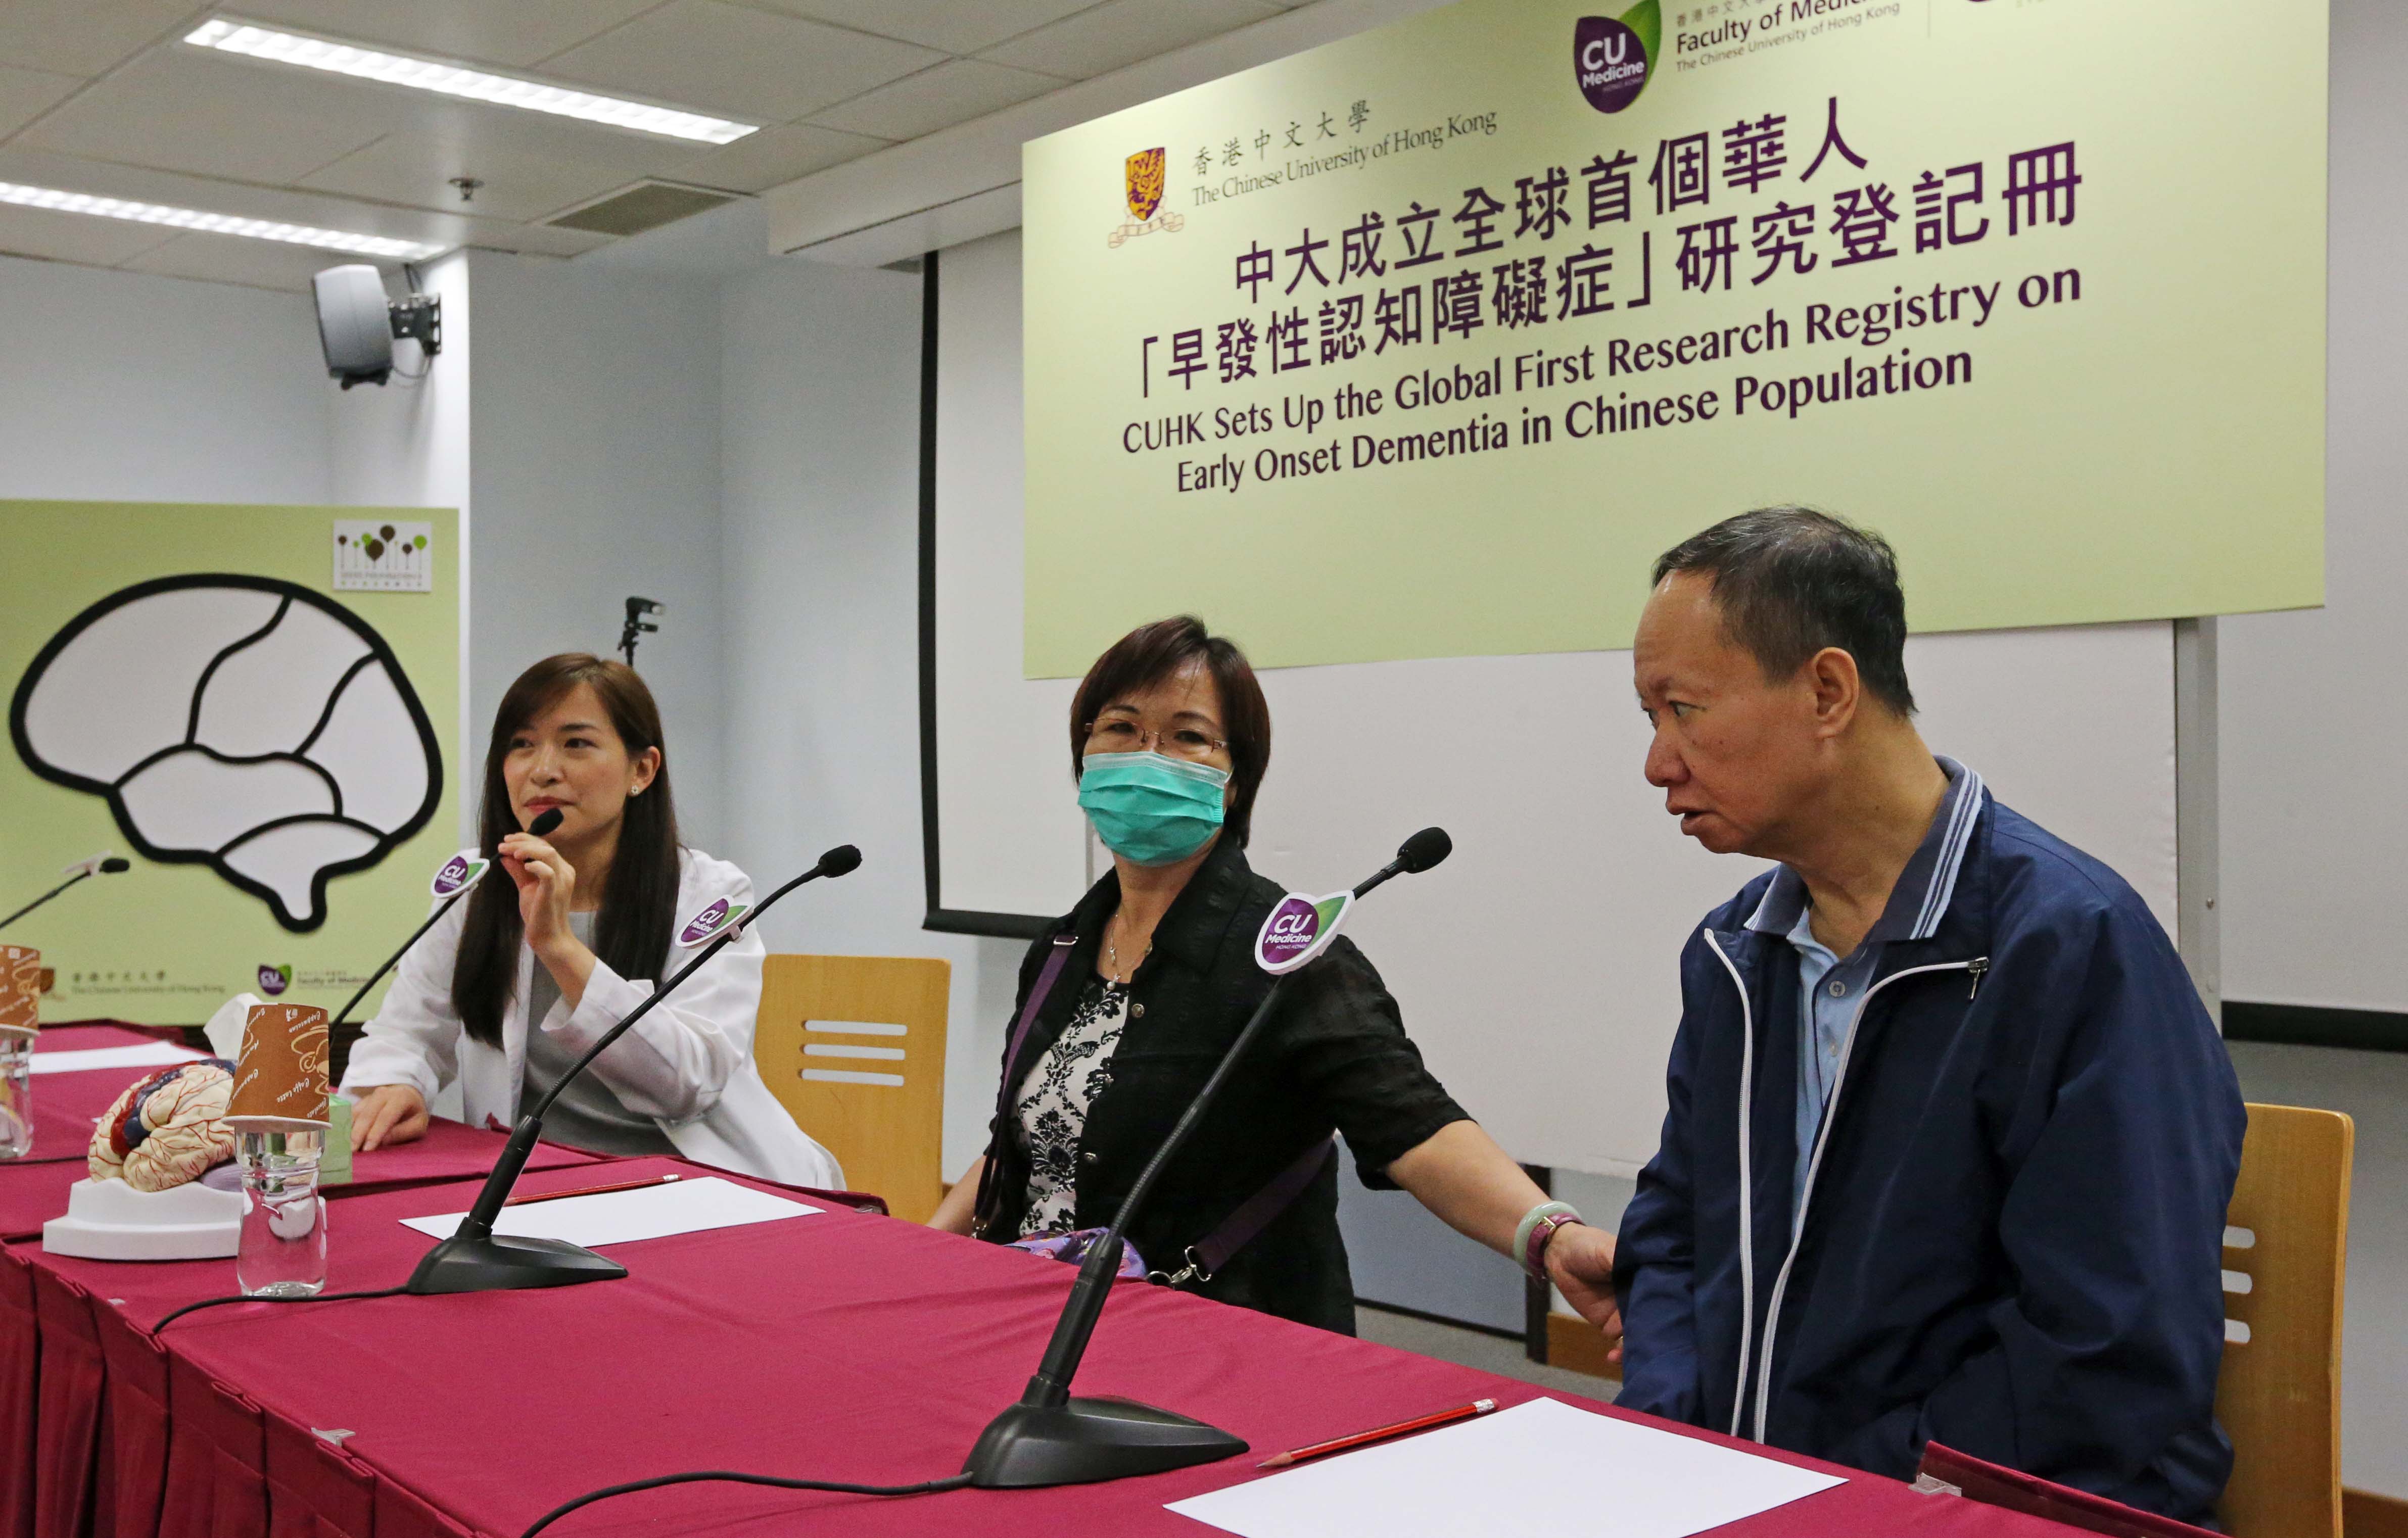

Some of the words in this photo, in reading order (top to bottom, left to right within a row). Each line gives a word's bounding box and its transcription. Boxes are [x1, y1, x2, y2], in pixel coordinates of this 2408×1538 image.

[1582, 32, 1626, 71] CU
[1677, 19, 1752, 55] Faculty
[1760, 4, 1783, 30] of
[1677, 60, 1696, 72] The
[1700, 46, 1744, 66] Chinese
[1748, 29, 1807, 53] University
[1811, 21, 1823, 35] of
[1827, 13, 1862, 31] Hong
[1866, 3, 1900, 20] Kong
[1582, 62, 1644, 88] Medicine
[1192, 100, 1371, 176] 香港中文大學
[1193, 185, 1219, 206] The
[1221, 171, 1283, 199] Chinese
[1287, 147, 1370, 181] University
[1372, 137, 1390, 159] of
[1393, 124, 1444, 154] Hong
[1446, 110, 1498, 140] Kong
[1236, 97, 1868, 304] 中大成立全球首個華人
[1143, 141, 2082, 398] 「早發性認知障礙症」研究登記冊
[1123, 412, 1205, 454] CUHK
[1215, 404, 1272, 440] Sets
[1284, 394, 1324, 435] Up
[1334, 382, 1383, 420] the
[1394, 356, 1500, 410] Global
[1516, 345, 1594, 392] First
[1609, 308, 1788, 376] Research
[1807, 281, 2000, 347] Registry
[2018, 268, 2080, 308] on
[1178, 453, 1245, 494] Early
[1255, 439, 1342, 481] Onset
[1353, 413, 1508, 469] Dementia
[1522, 407, 1551, 445] in
[1565, 390, 1719, 438] Chinese
[1735, 350, 1972, 419] Population
[699, 909, 724, 925] CU
[1265, 933, 1312, 944] Medicine
[1273, 914, 1313, 934] CU
